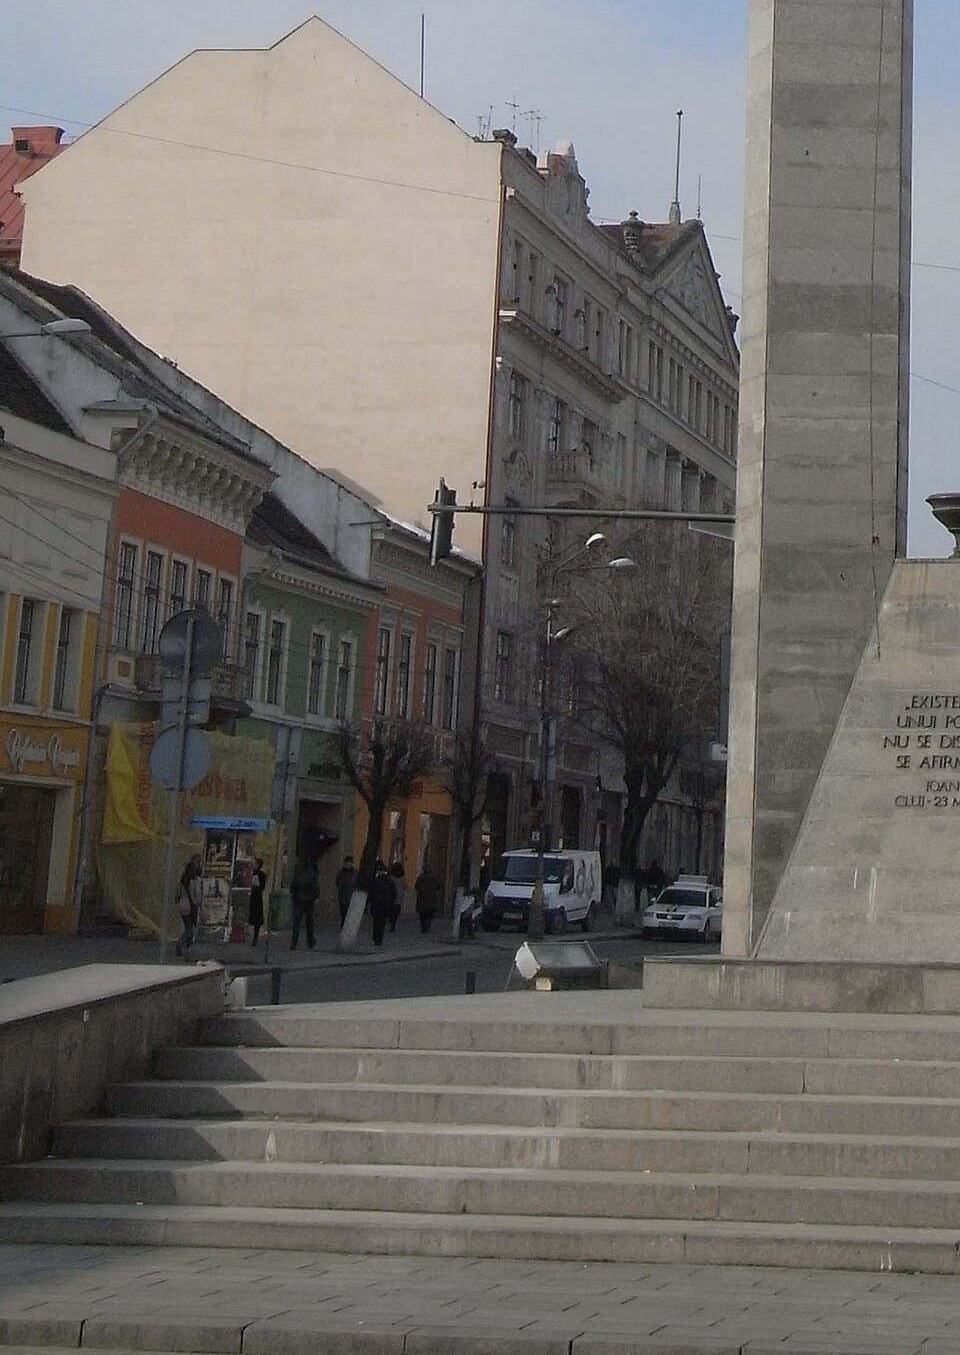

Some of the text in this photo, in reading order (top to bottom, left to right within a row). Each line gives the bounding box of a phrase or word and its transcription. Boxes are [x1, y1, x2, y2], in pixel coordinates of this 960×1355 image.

[897, 715, 937, 729] UNUI
[883, 735, 910, 749] NU
[917, 735, 932, 749] SE
[896, 755, 911, 769] SE
[926, 780, 960, 792] IOAN
